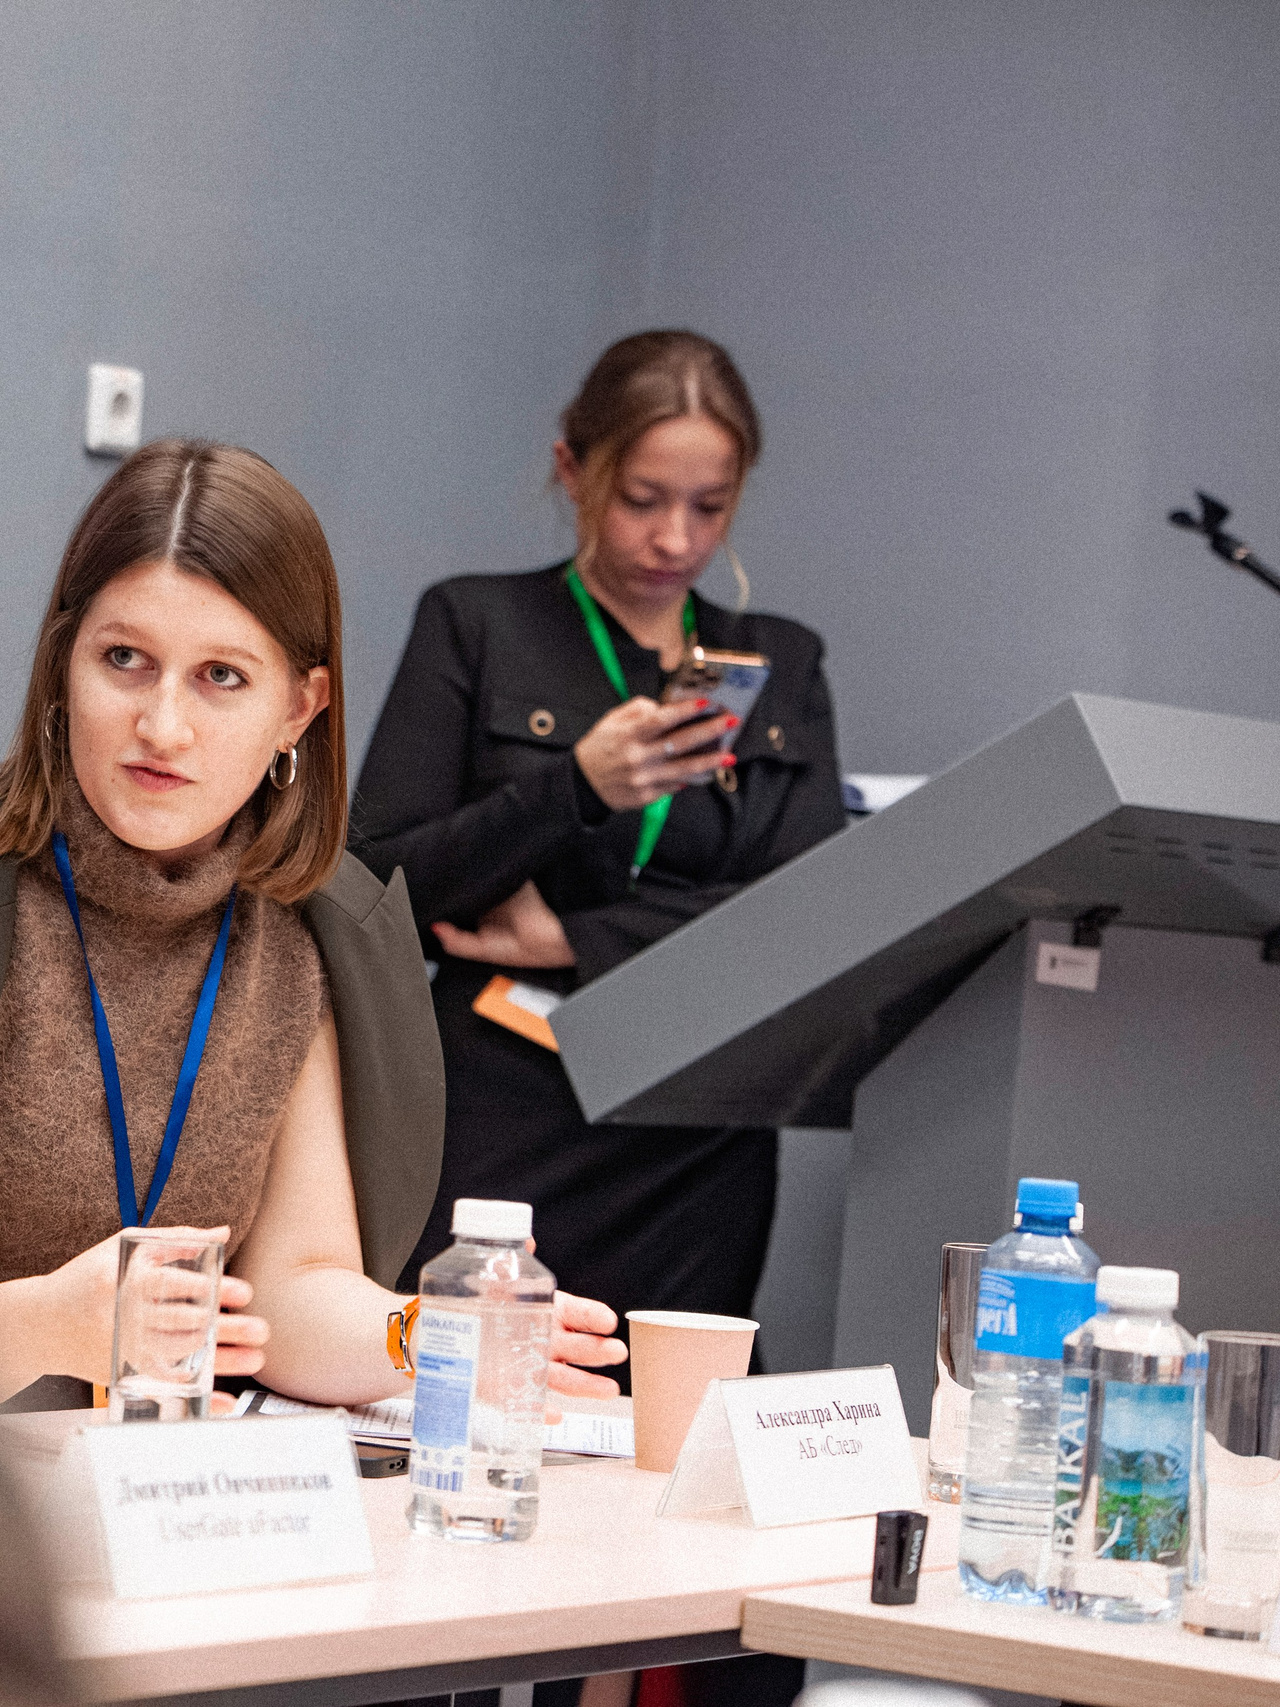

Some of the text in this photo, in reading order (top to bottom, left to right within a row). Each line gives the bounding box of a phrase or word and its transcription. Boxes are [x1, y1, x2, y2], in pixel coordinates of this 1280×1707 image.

[754, 1400, 882, 1430] Александра Харина
[799, 1435, 863, 1460] АБ «След»
[1055, 1391, 1086, 1550] BAIKAL
